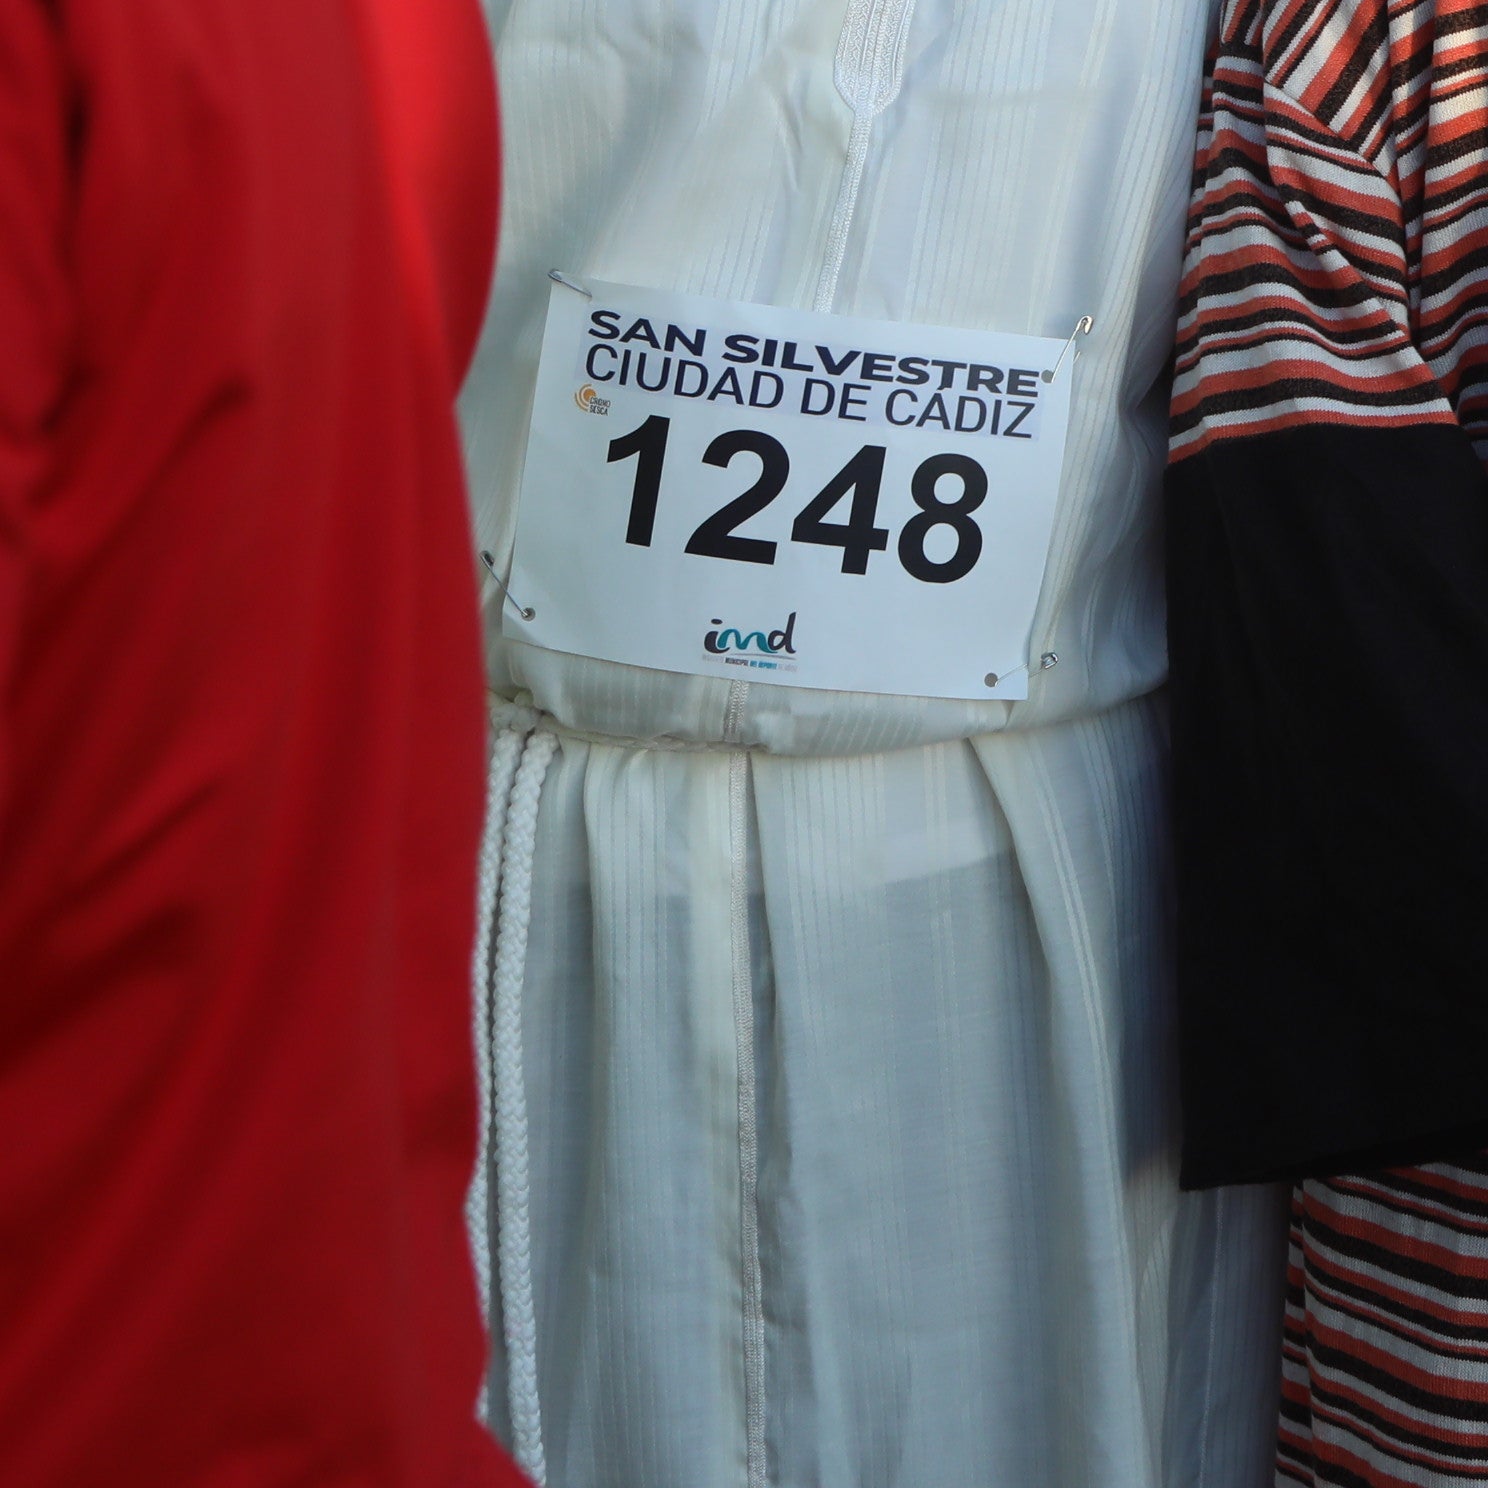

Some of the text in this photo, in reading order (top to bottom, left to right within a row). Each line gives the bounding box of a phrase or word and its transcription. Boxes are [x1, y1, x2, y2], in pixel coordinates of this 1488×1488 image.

[585, 344, 784, 410] CIUDAD
[799, 379, 872, 422] DE
[588, 310, 1040, 398] SAN SILVESTRE
[606, 414, 989, 585] 1248
[703, 611, 797, 654] imd
